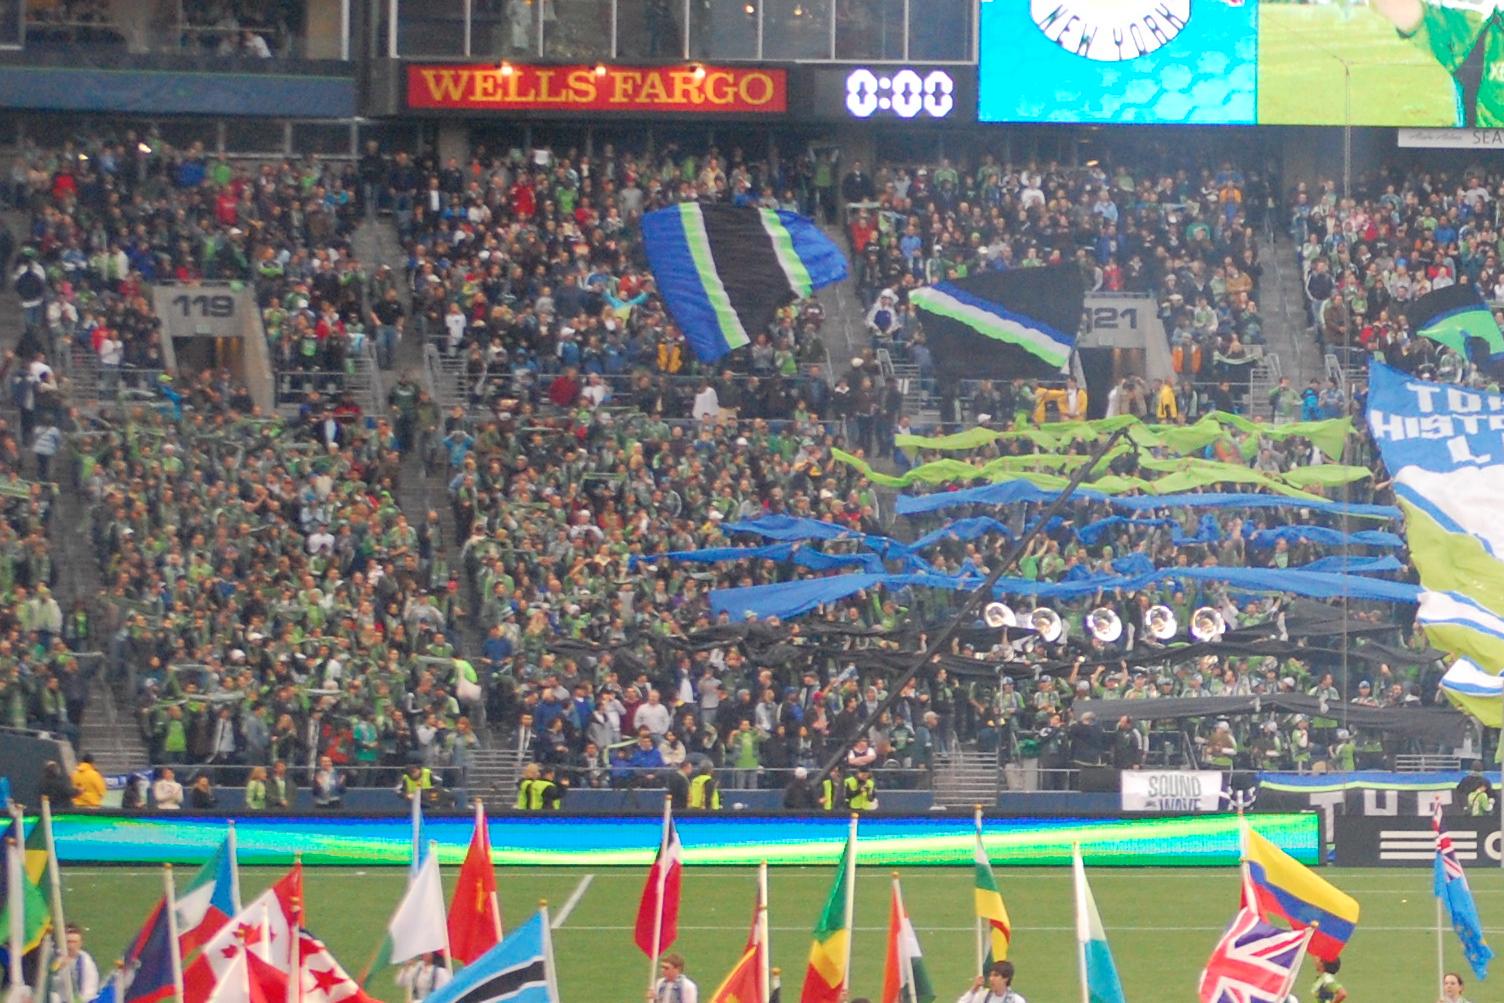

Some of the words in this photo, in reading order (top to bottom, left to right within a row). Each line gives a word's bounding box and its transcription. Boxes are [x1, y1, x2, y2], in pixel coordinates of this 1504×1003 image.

[1036, 3, 1097, 58] NEW
[1112, 3, 1188, 61] YORK
[422, 69, 597, 104] WELLS
[609, 70, 775, 106] FARGO
[846, 68, 953, 118] 0:00
[172, 295, 234, 317] 119
[1148, 775, 1202, 798] SOUND
